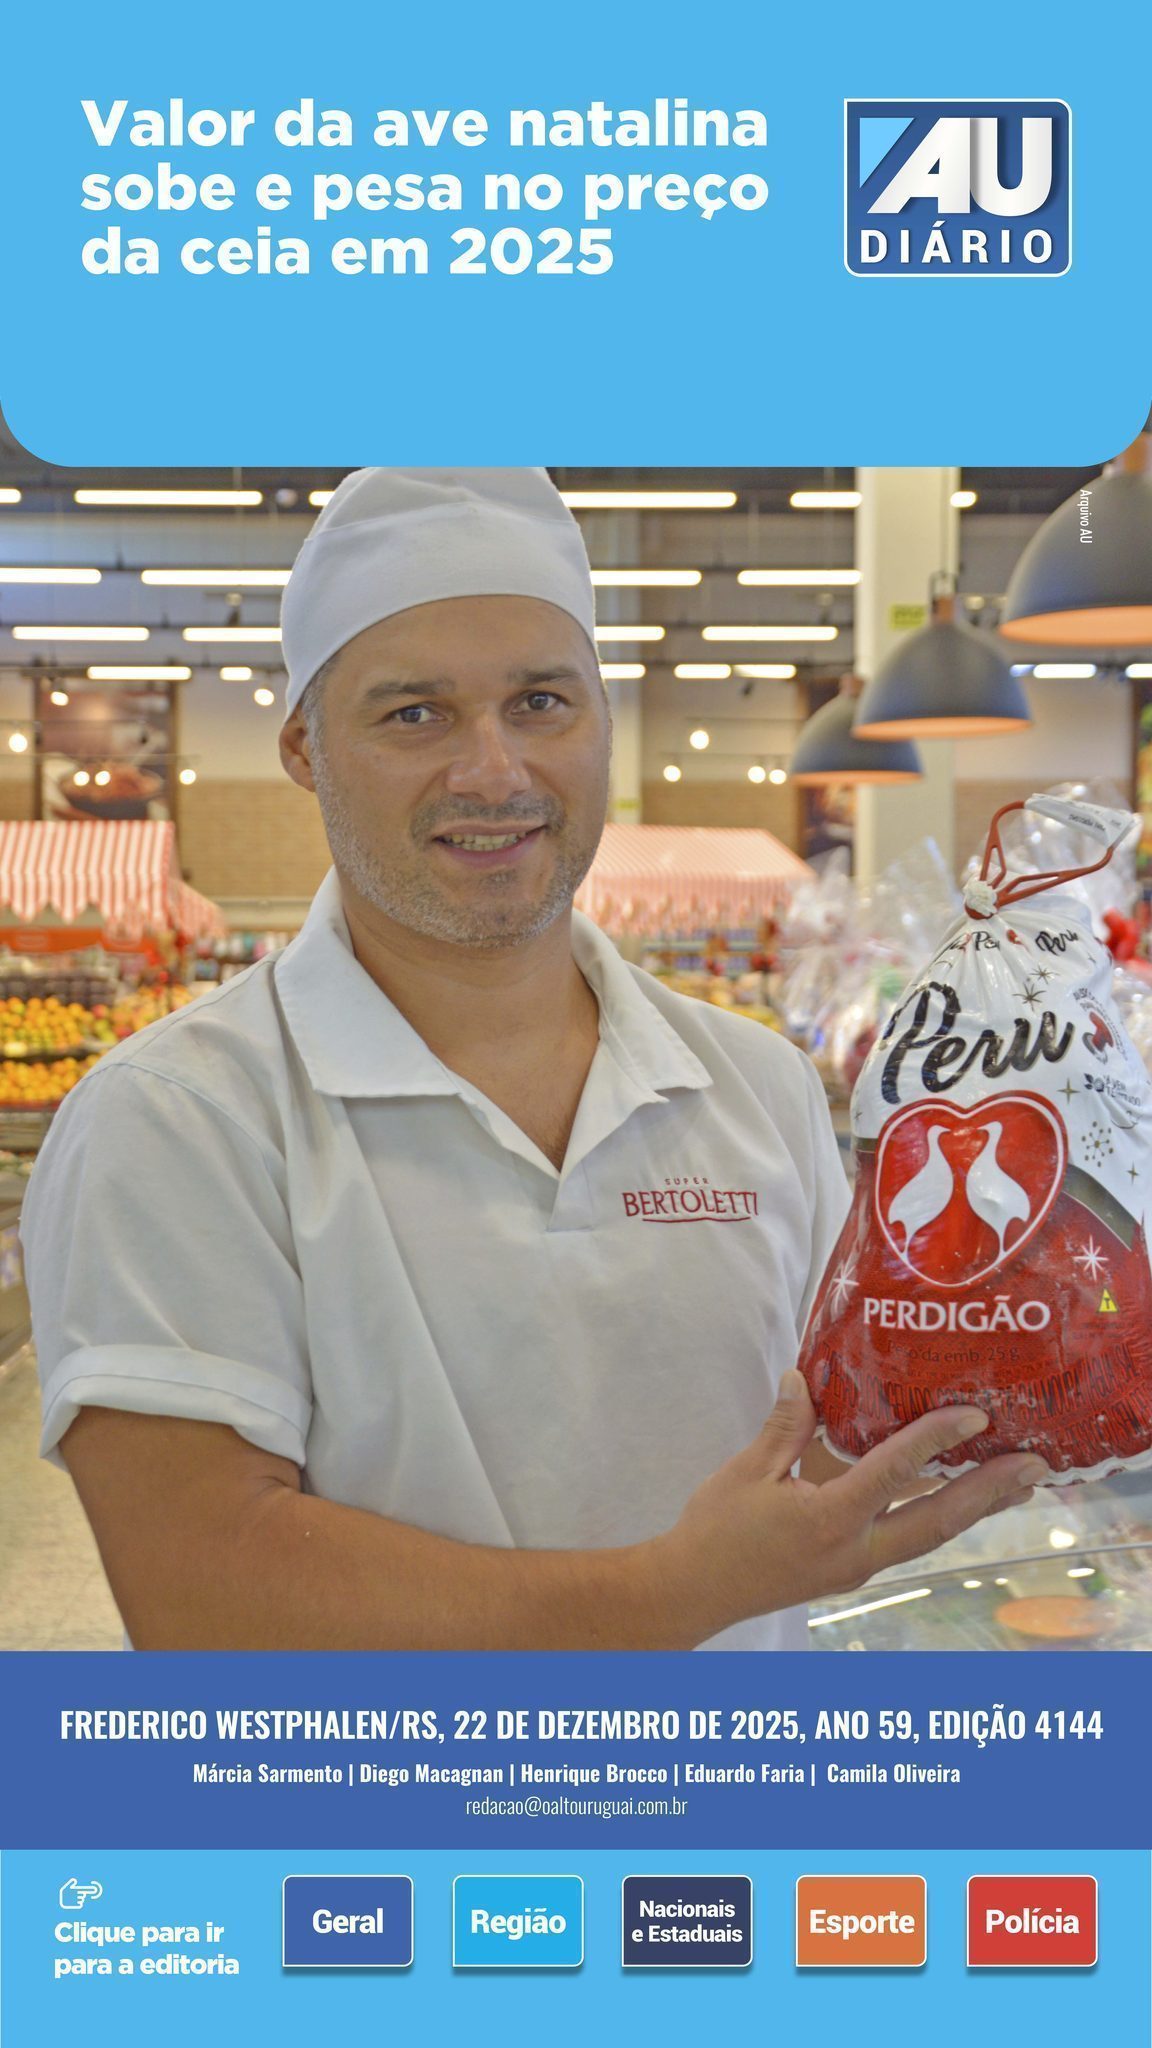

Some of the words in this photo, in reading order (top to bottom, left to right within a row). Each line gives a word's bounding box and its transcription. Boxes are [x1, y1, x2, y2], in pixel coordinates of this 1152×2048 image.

[881, 981, 1074, 1104] Peru
[664, 1177, 710, 1186] SUPER
[622, 1189, 759, 1217] BERTOLETTI
[863, 1295, 1051, 1332] PERDIGÃO
